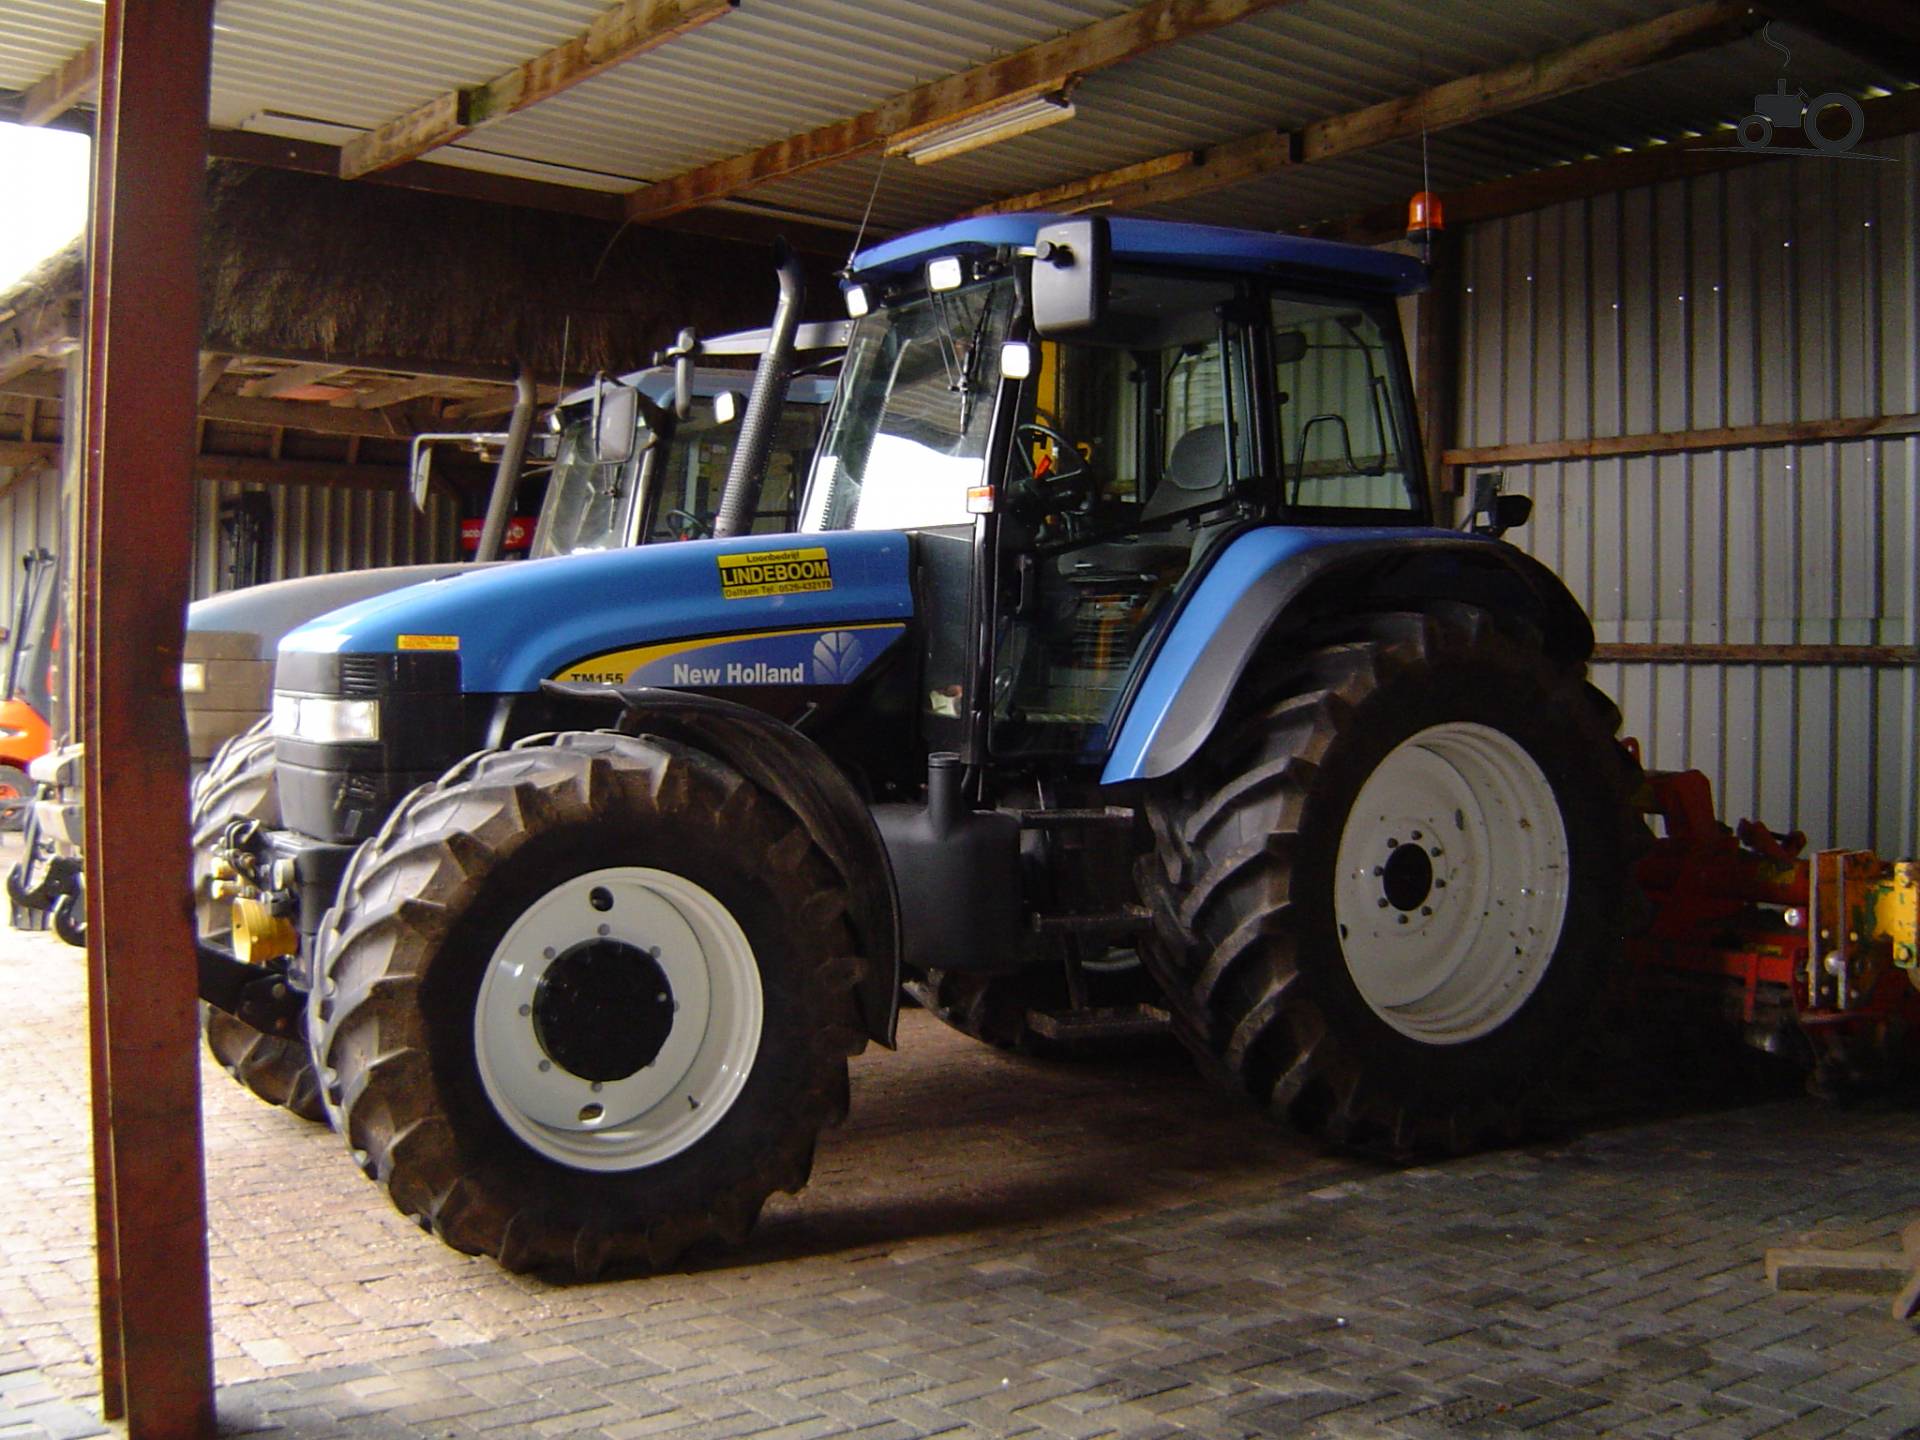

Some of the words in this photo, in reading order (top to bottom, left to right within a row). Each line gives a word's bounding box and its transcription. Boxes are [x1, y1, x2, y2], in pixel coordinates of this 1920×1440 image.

[722, 562, 830, 586] LINDEBOOM
[571, 672, 624, 685] TM155
[674, 664, 721, 685] New
[727, 663, 804, 684] Holland
